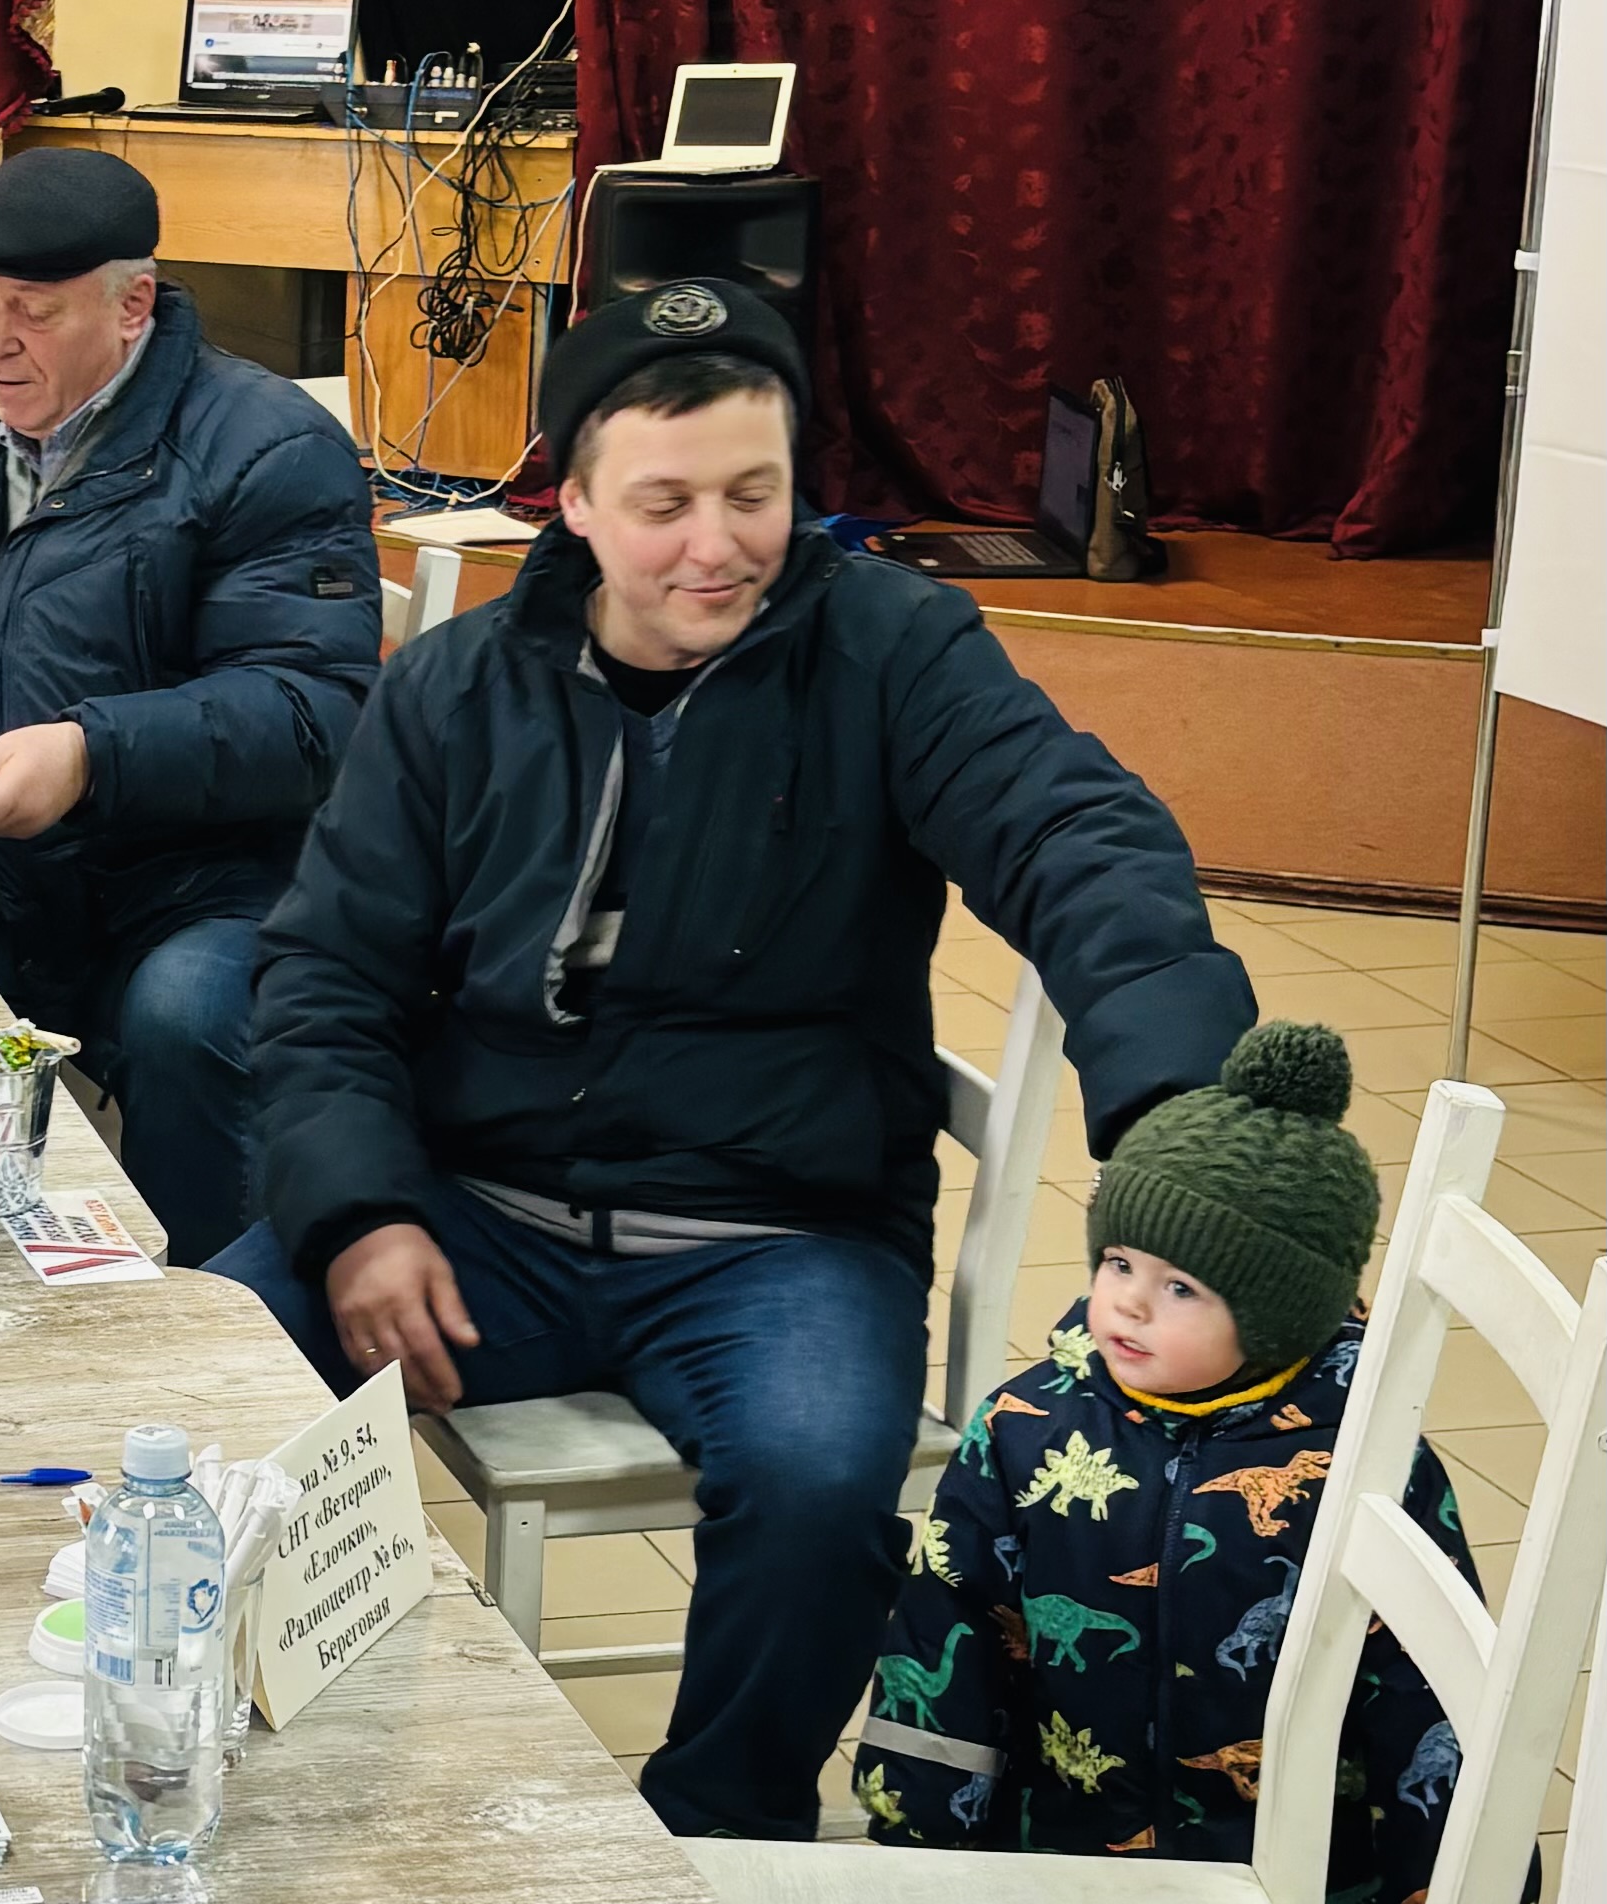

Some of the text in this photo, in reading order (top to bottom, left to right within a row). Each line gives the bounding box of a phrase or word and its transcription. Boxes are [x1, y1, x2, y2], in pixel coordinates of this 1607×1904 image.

[322, 1449, 338, 1481] №
[340, 1439, 356, 1468] 9,
[278, 1464, 391, 1559] СНТ «Ветеран»,
[303, 1520, 377, 1585] «Елочки»,
[279, 1532, 414, 1652] «Радиоцентр № 6»,
[317, 1596, 391, 1670] Береговая
